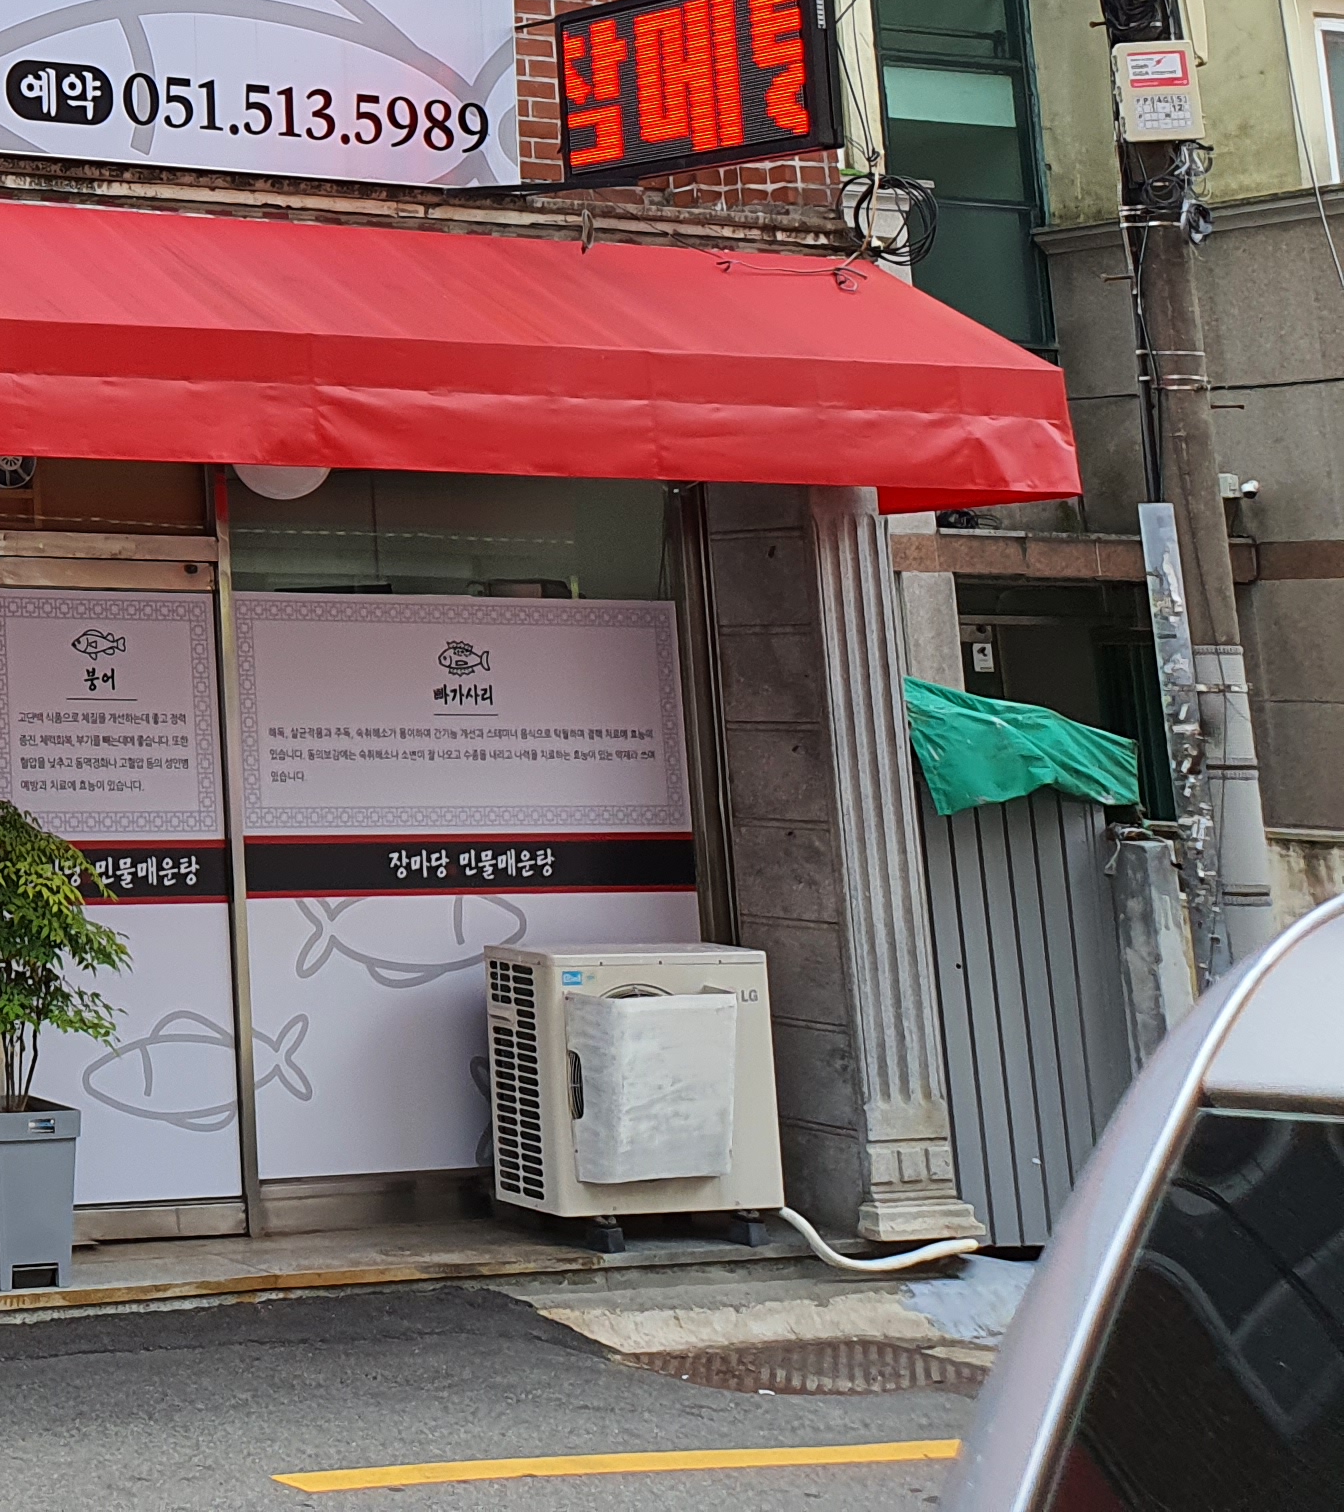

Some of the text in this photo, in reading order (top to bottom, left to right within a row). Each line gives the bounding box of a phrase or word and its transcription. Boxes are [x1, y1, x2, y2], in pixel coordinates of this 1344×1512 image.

[20, 67, 490, 153] 예약 051.513.5989
[83, 668, 116, 691] 붕어
[433, 684, 494, 707] 빠가사리
[95, 856, 200, 888] 민물매운탕
[388, 848, 556, 880] 장마당 민물매운탕
[741, 990, 759, 1003] LG
